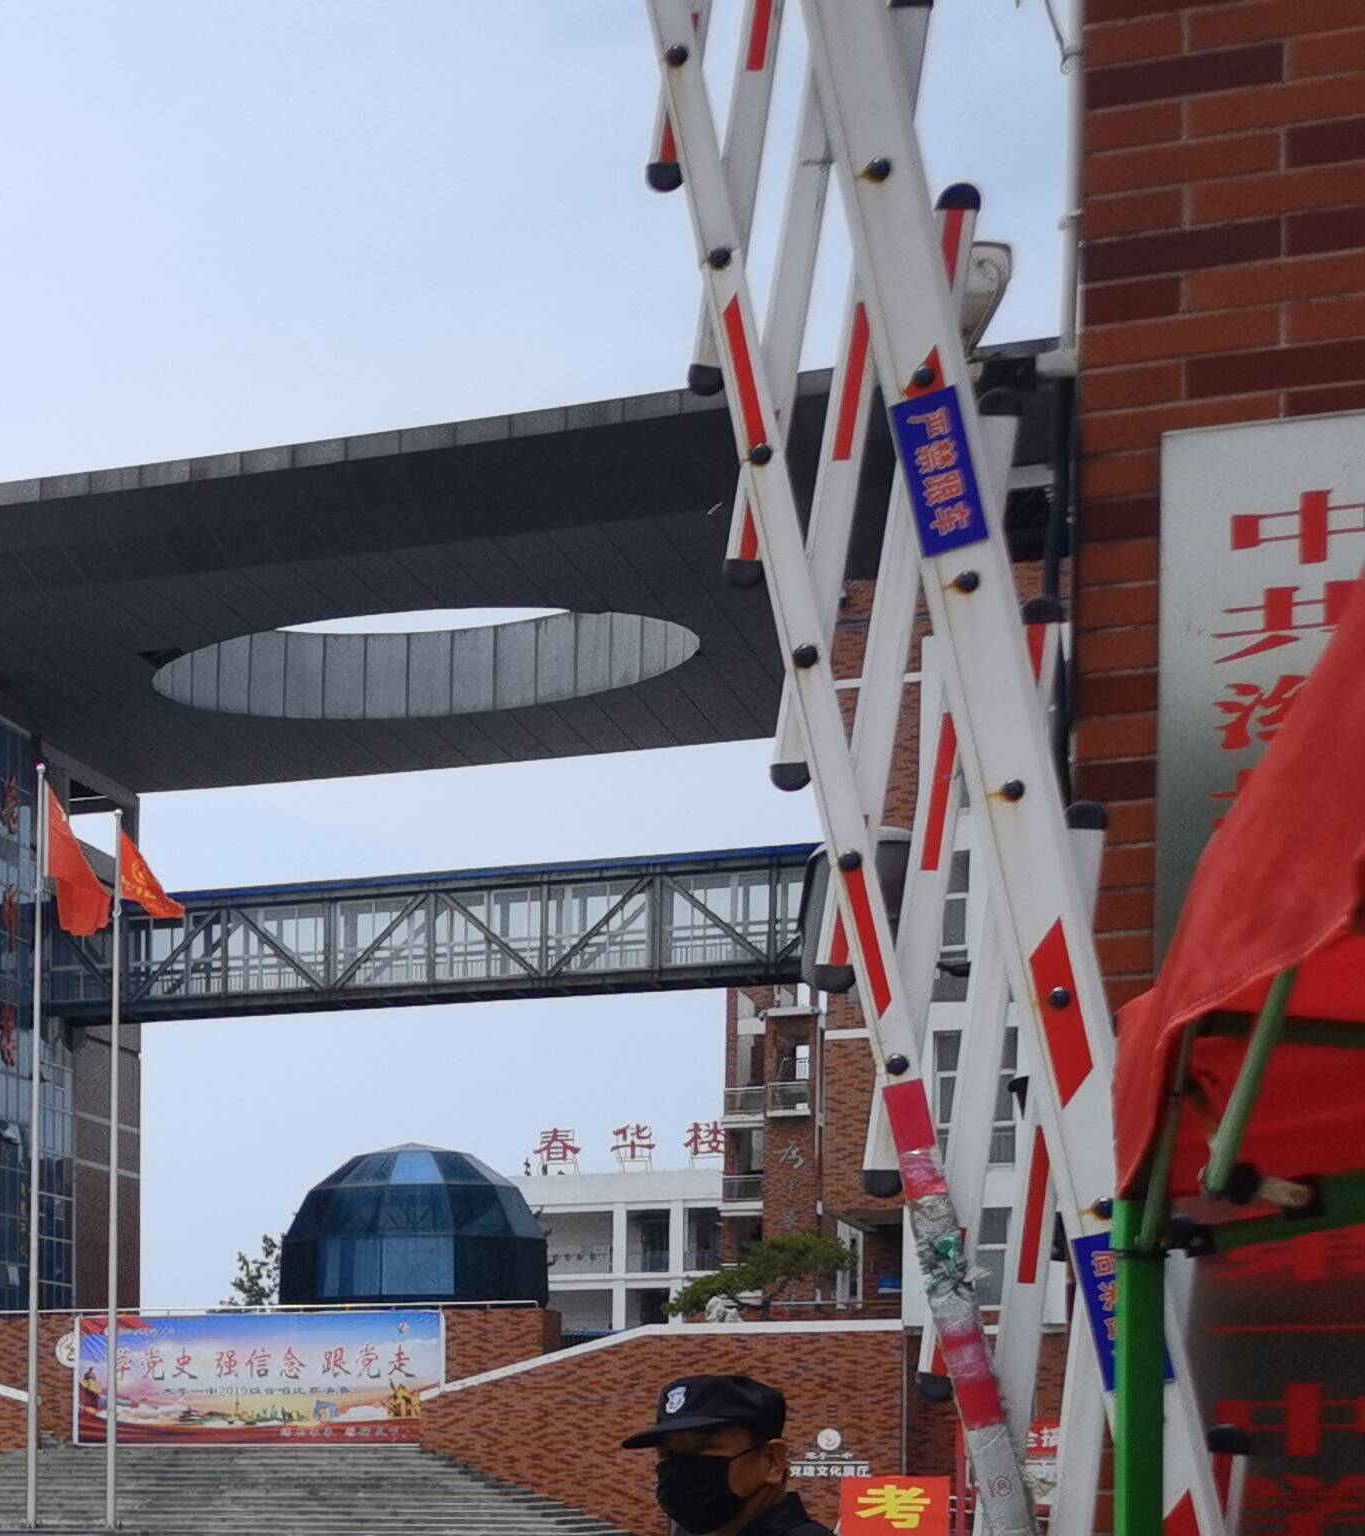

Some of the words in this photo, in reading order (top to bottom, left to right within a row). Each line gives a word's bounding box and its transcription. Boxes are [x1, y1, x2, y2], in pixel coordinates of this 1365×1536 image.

[533, 1120, 725, 1162] 春华楼
[114, 1347, 198, 1381] 学党史
[215, 1347, 306, 1380] 强信念
[321, 1345, 416, 1380] 跟党走
